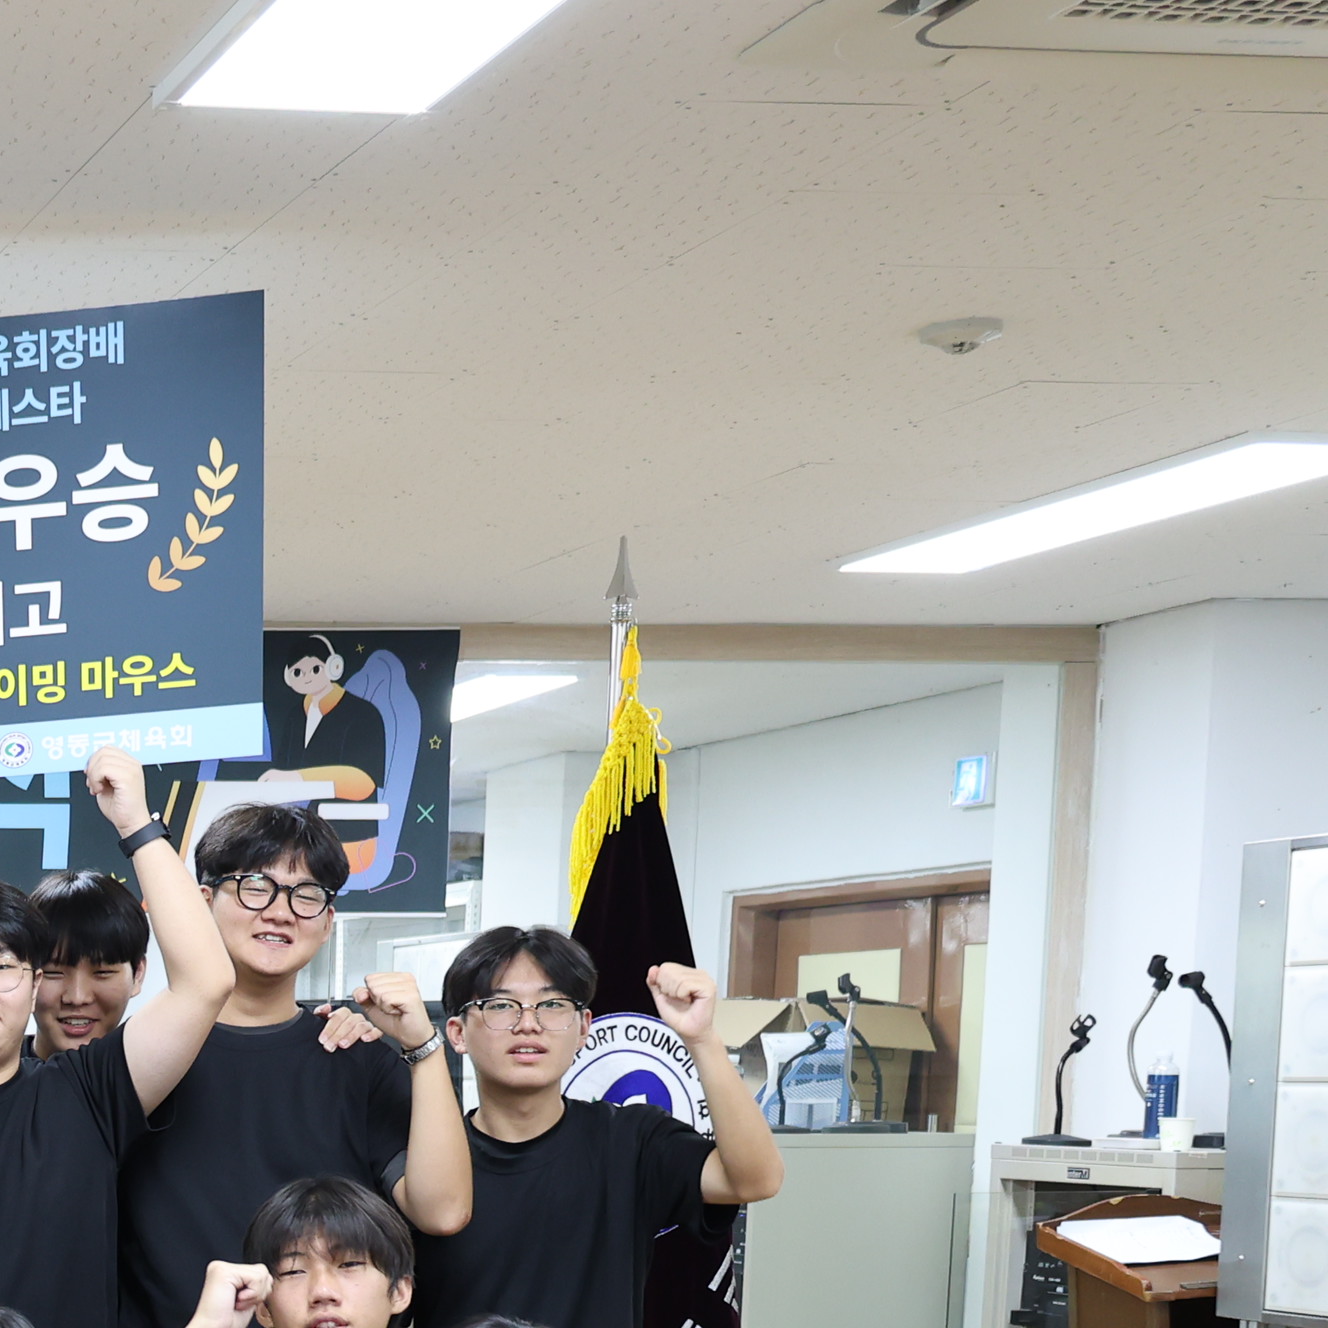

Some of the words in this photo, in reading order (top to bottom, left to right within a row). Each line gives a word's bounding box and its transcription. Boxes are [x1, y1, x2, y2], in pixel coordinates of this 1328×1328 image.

[81, 653, 196, 698] 마우스
[41, 724, 193, 760] 영동군체육회
[624, 1024, 695, 1079] COUNCIL
